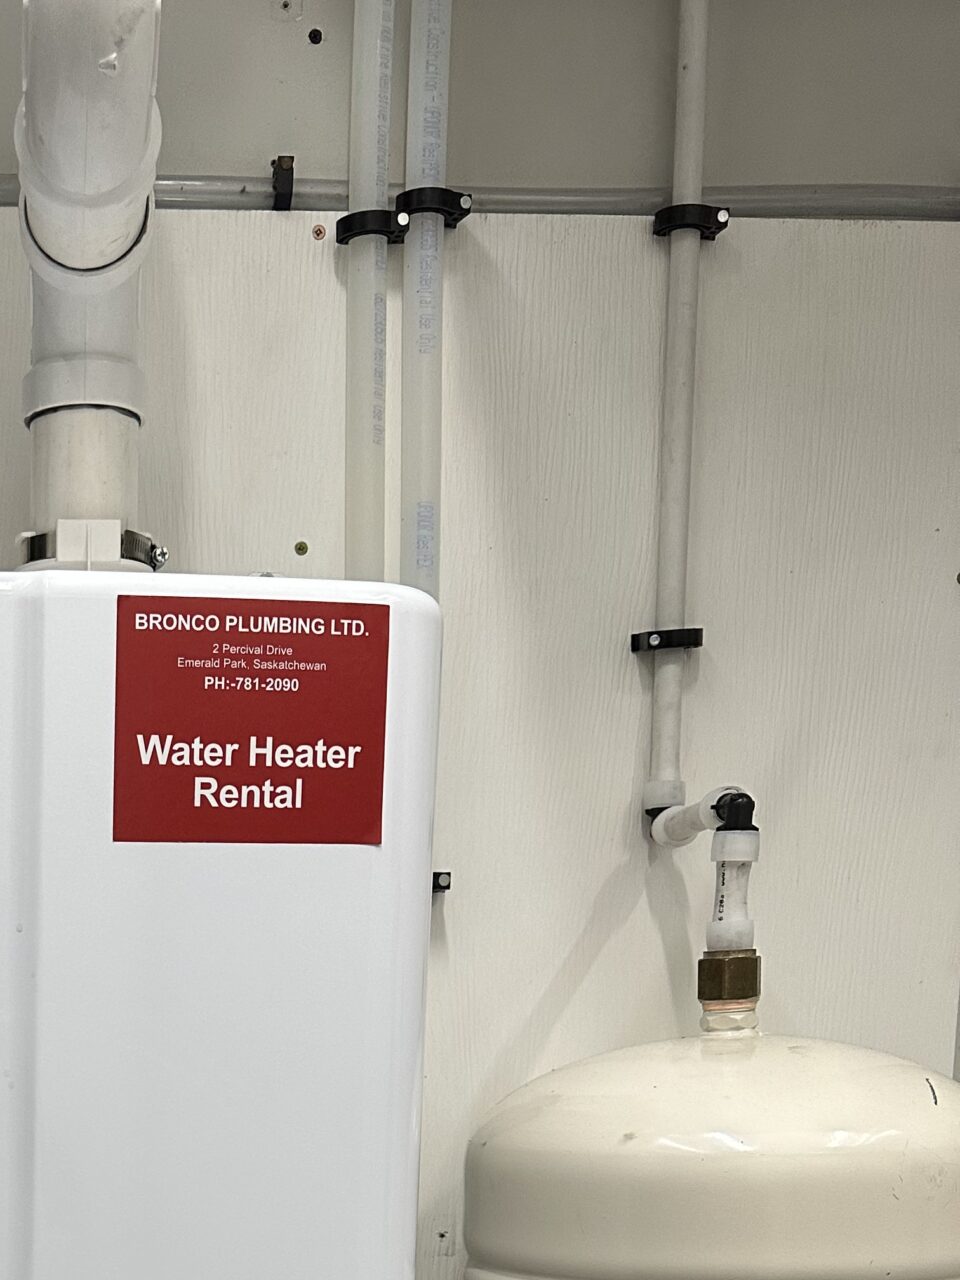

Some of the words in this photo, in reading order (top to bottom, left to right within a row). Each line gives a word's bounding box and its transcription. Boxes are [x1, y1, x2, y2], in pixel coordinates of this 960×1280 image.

[135, 613, 220, 632] BRONCO
[225, 615, 325, 635] PLUMBING
[330, 619, 370, 637] LTD.
[212, 643, 220, 655] 2
[222, 643, 263, 656] Percival
[266, 645, 293, 656] Drive
[177, 657, 221, 669] Emerald
[224, 658, 250, 670] Park,
[253, 658, 327, 671] Saskatchewan
[204, 676, 300, 692] PH:-781-2090
[136, 734, 240, 767] Water
[249, 736, 362, 769] Heater
[193, 776, 303, 809] Rental
